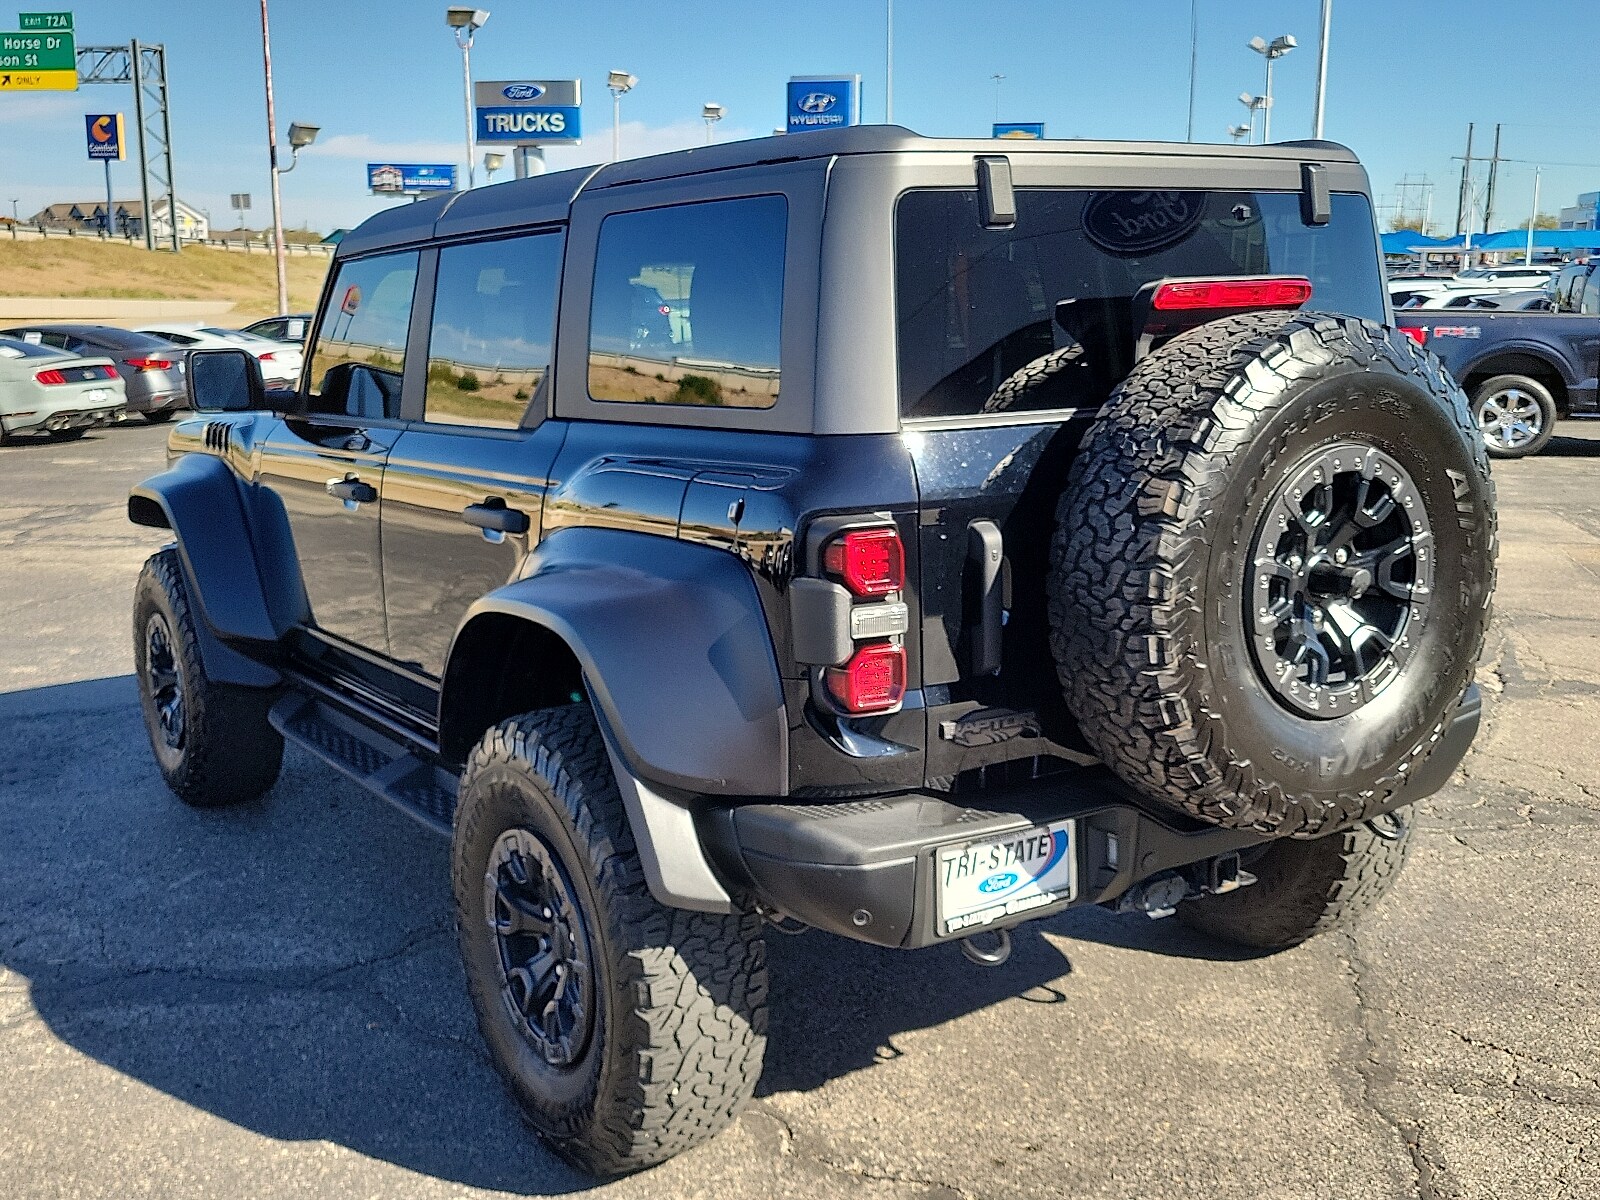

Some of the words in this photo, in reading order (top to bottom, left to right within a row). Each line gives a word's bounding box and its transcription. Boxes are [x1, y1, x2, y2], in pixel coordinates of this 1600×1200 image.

[45, 15, 68, 27] 72A
[4, 37, 41, 50] Horse
[46, 36, 61, 49] Dr
[24, 54, 38, 66] St
[16, 76, 41, 86] ONLY
[507, 86, 534, 98] Ford
[485, 112, 565, 133] TRUCKS
[1433, 326, 1481, 339] FX4
[943, 834, 1051, 888] TRI-STATE
[985, 873, 1013, 893] Ford
